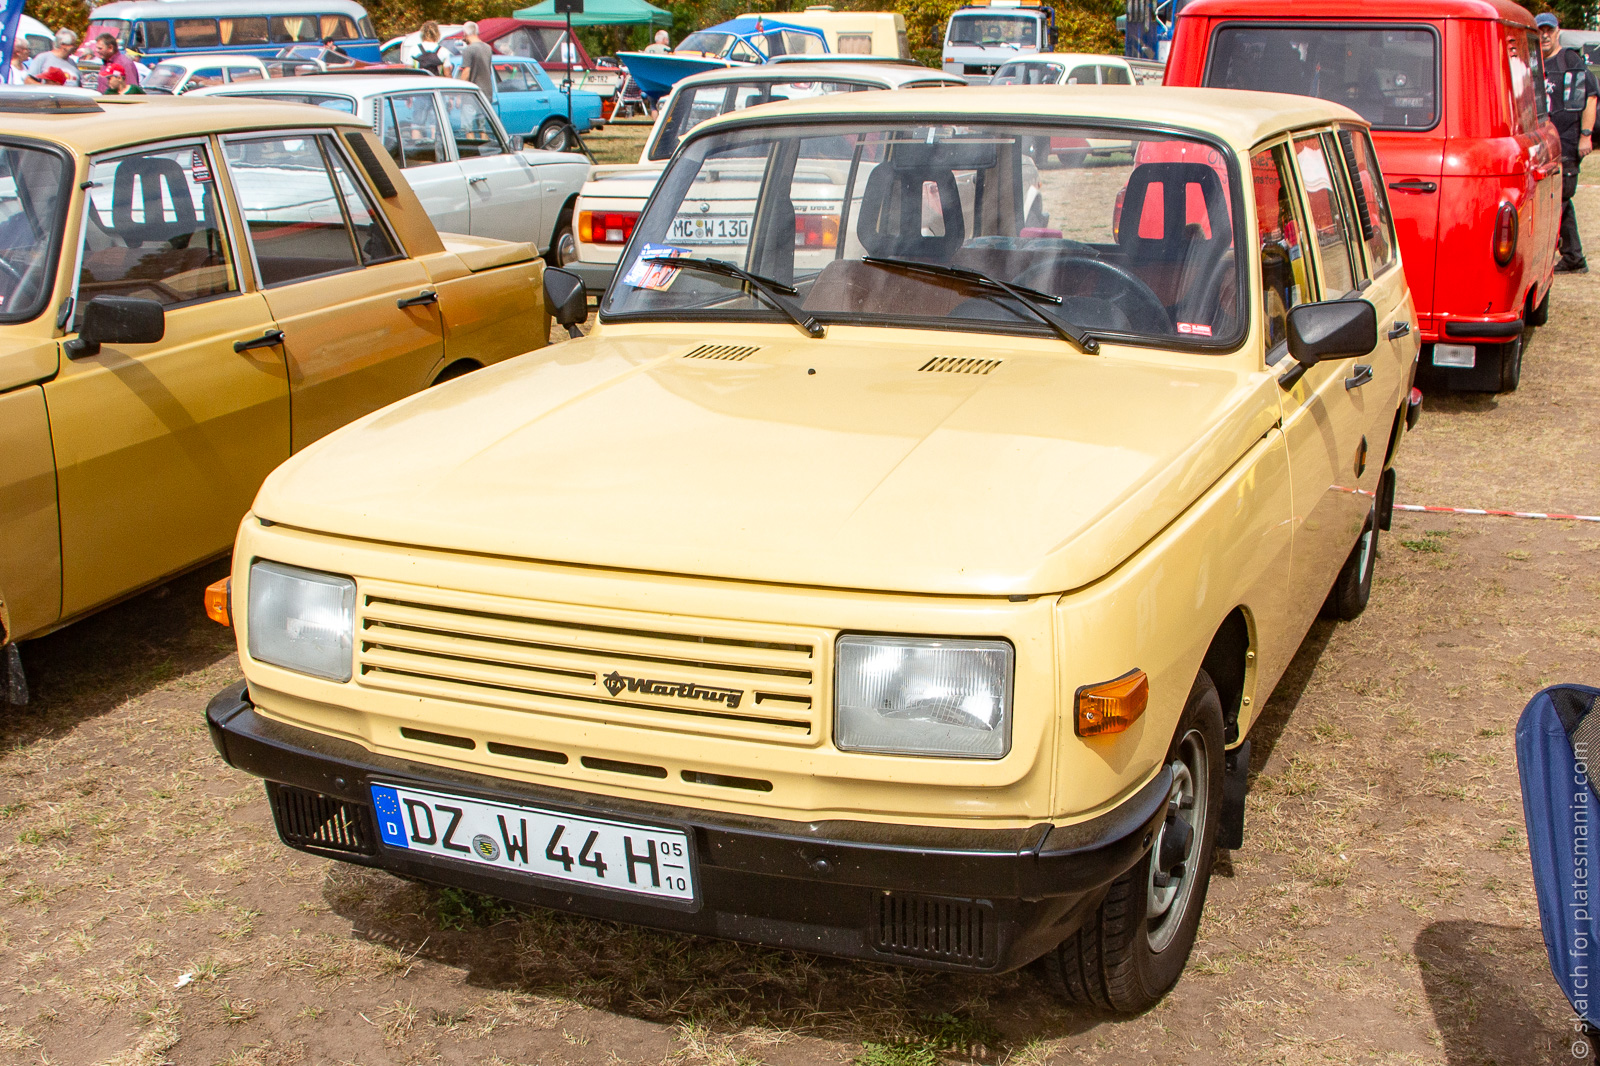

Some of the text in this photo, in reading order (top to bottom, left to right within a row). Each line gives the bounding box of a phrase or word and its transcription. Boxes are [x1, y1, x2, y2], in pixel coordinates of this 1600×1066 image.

[673, 220, 748, 237] MC W 130
[627, 677, 745, 708] Wartburg
[386, 821, 398, 836] D
[403, 797, 471, 853] DZ
[496, 814, 530, 865] W
[660, 840, 683, 857] 05
[665, 875, 687, 891] 10
